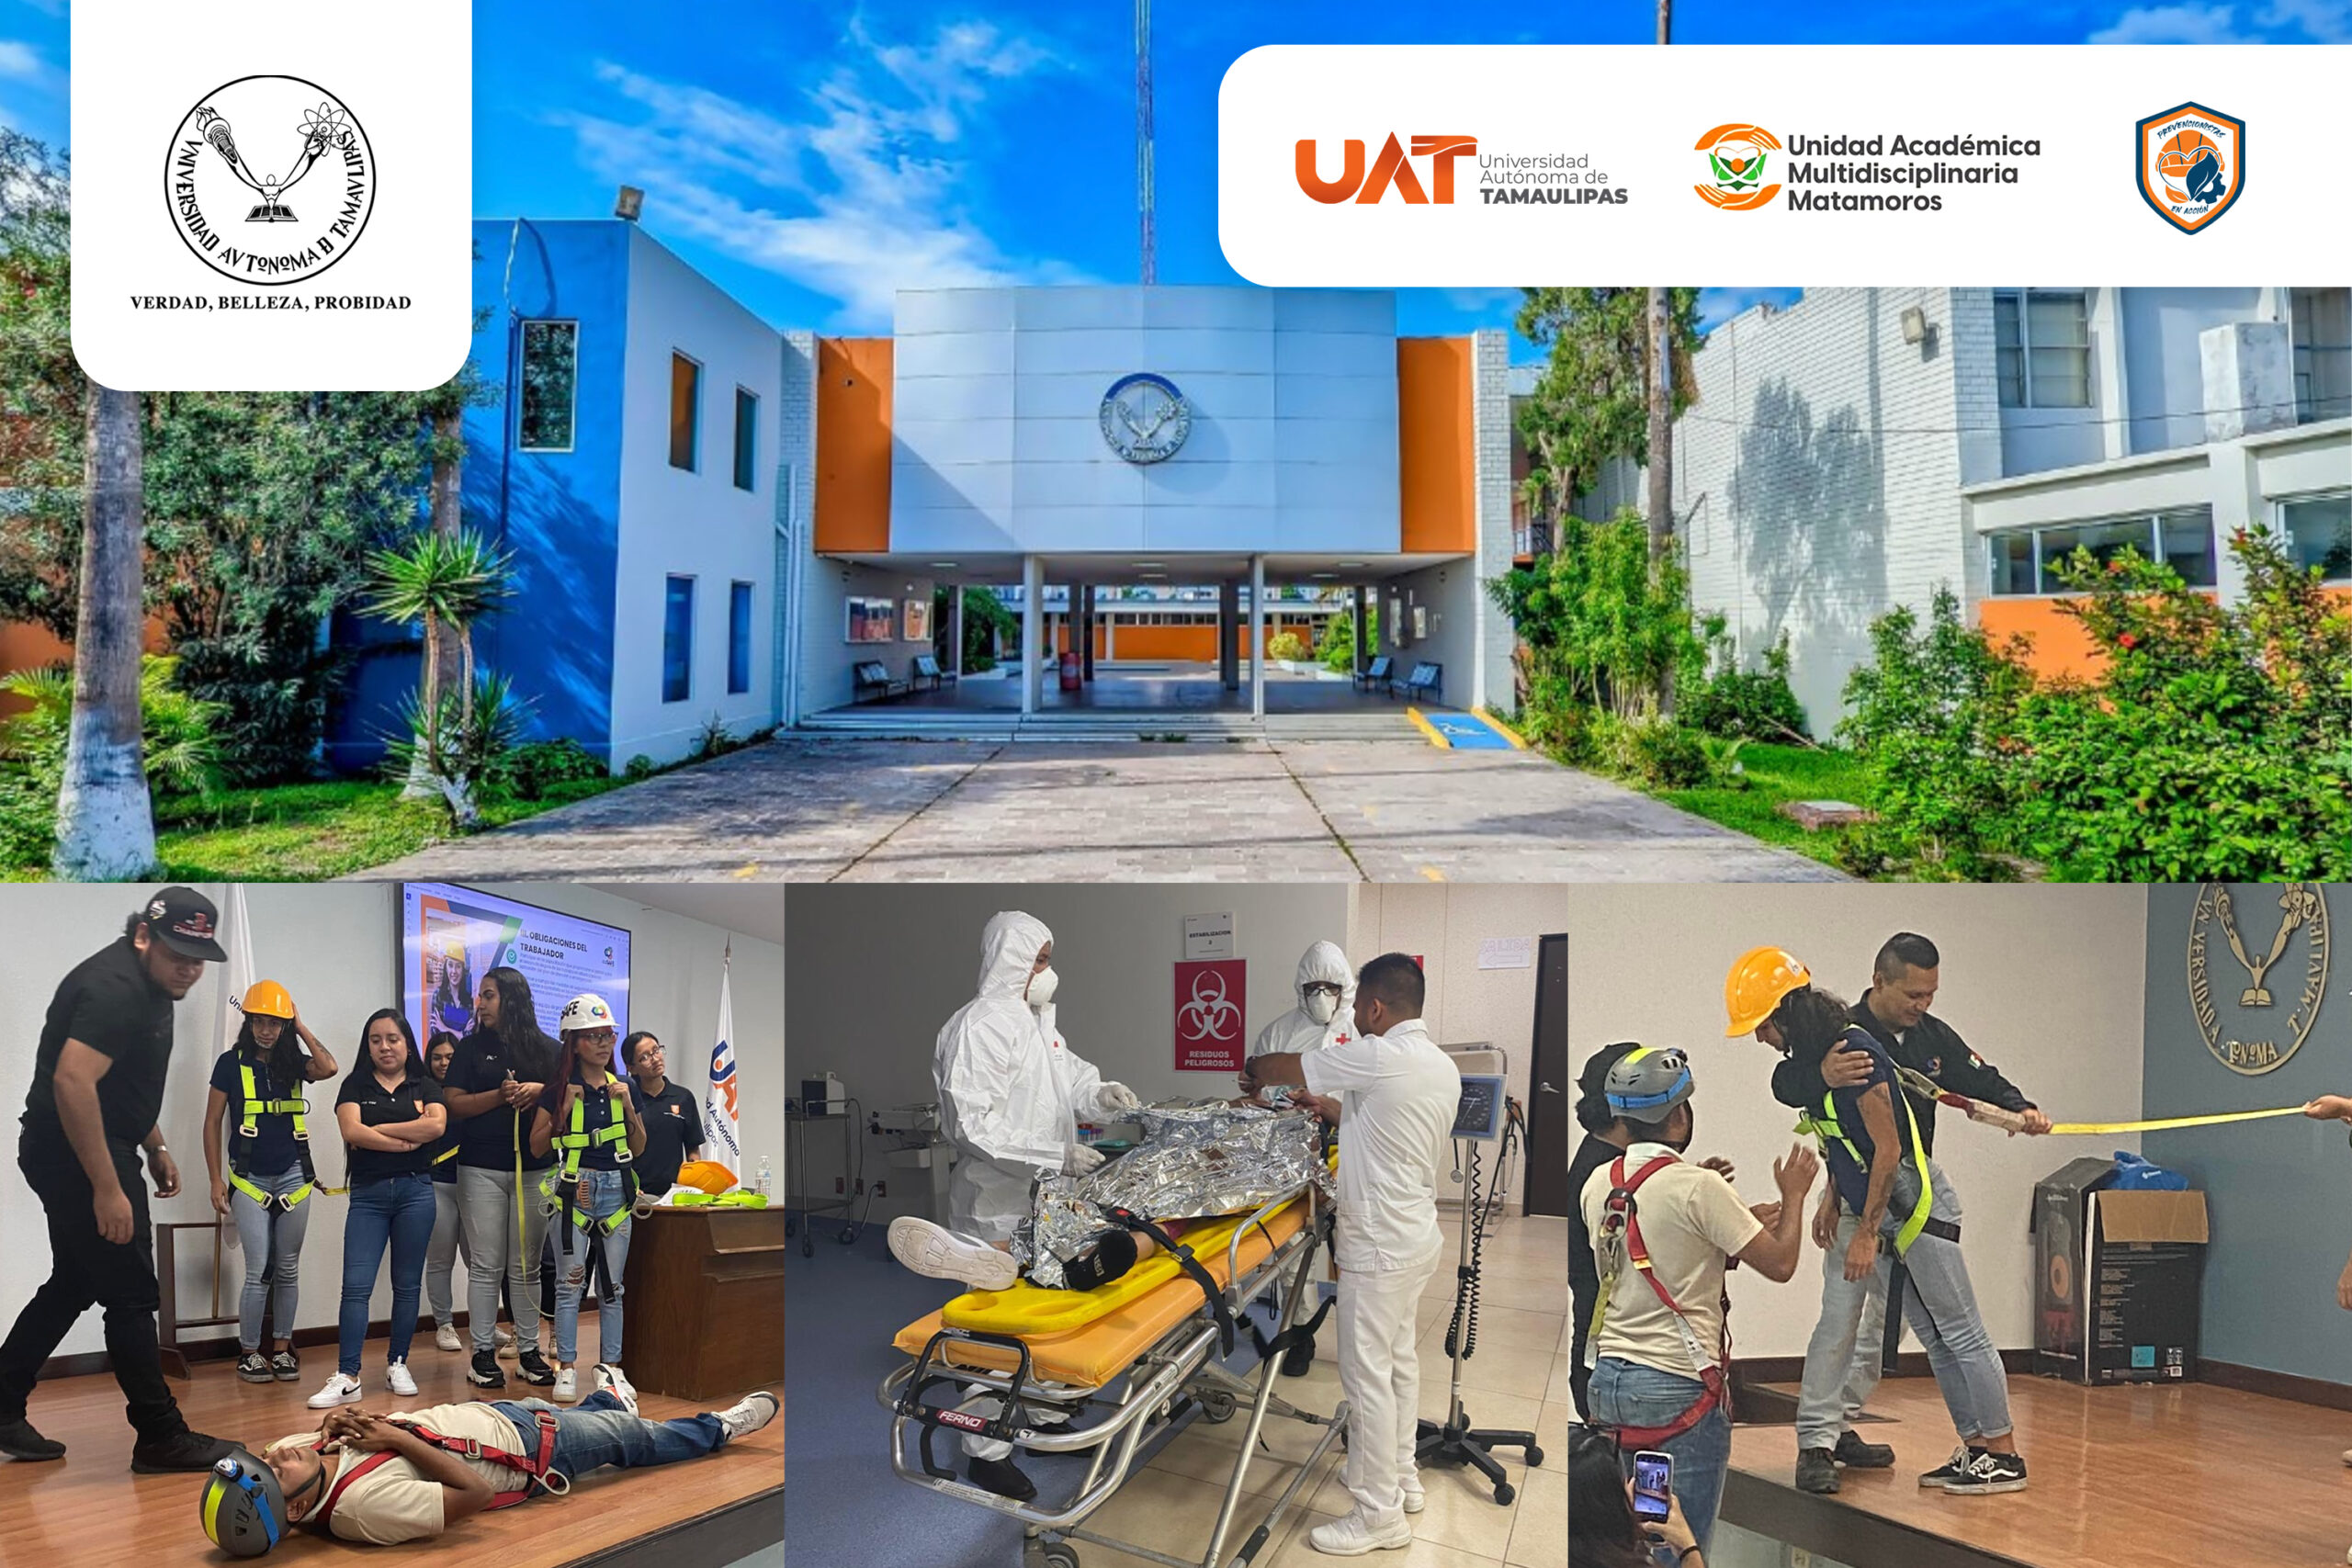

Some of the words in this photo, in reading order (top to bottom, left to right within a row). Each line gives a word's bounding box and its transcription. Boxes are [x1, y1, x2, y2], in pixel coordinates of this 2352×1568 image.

[520, 942, 564, 960] TRABAJADOR
[529, 931, 576, 949] OBLIGACIONES
[576, 942, 588, 953] DEL
[1184, 1059, 1234, 1067] PELIGROSOS
[1189, 1050, 1230, 1058] RESIDUOS
[708, 1108, 740, 1156] Autónoma
[938, 1410, 981, 1428] FERNO
